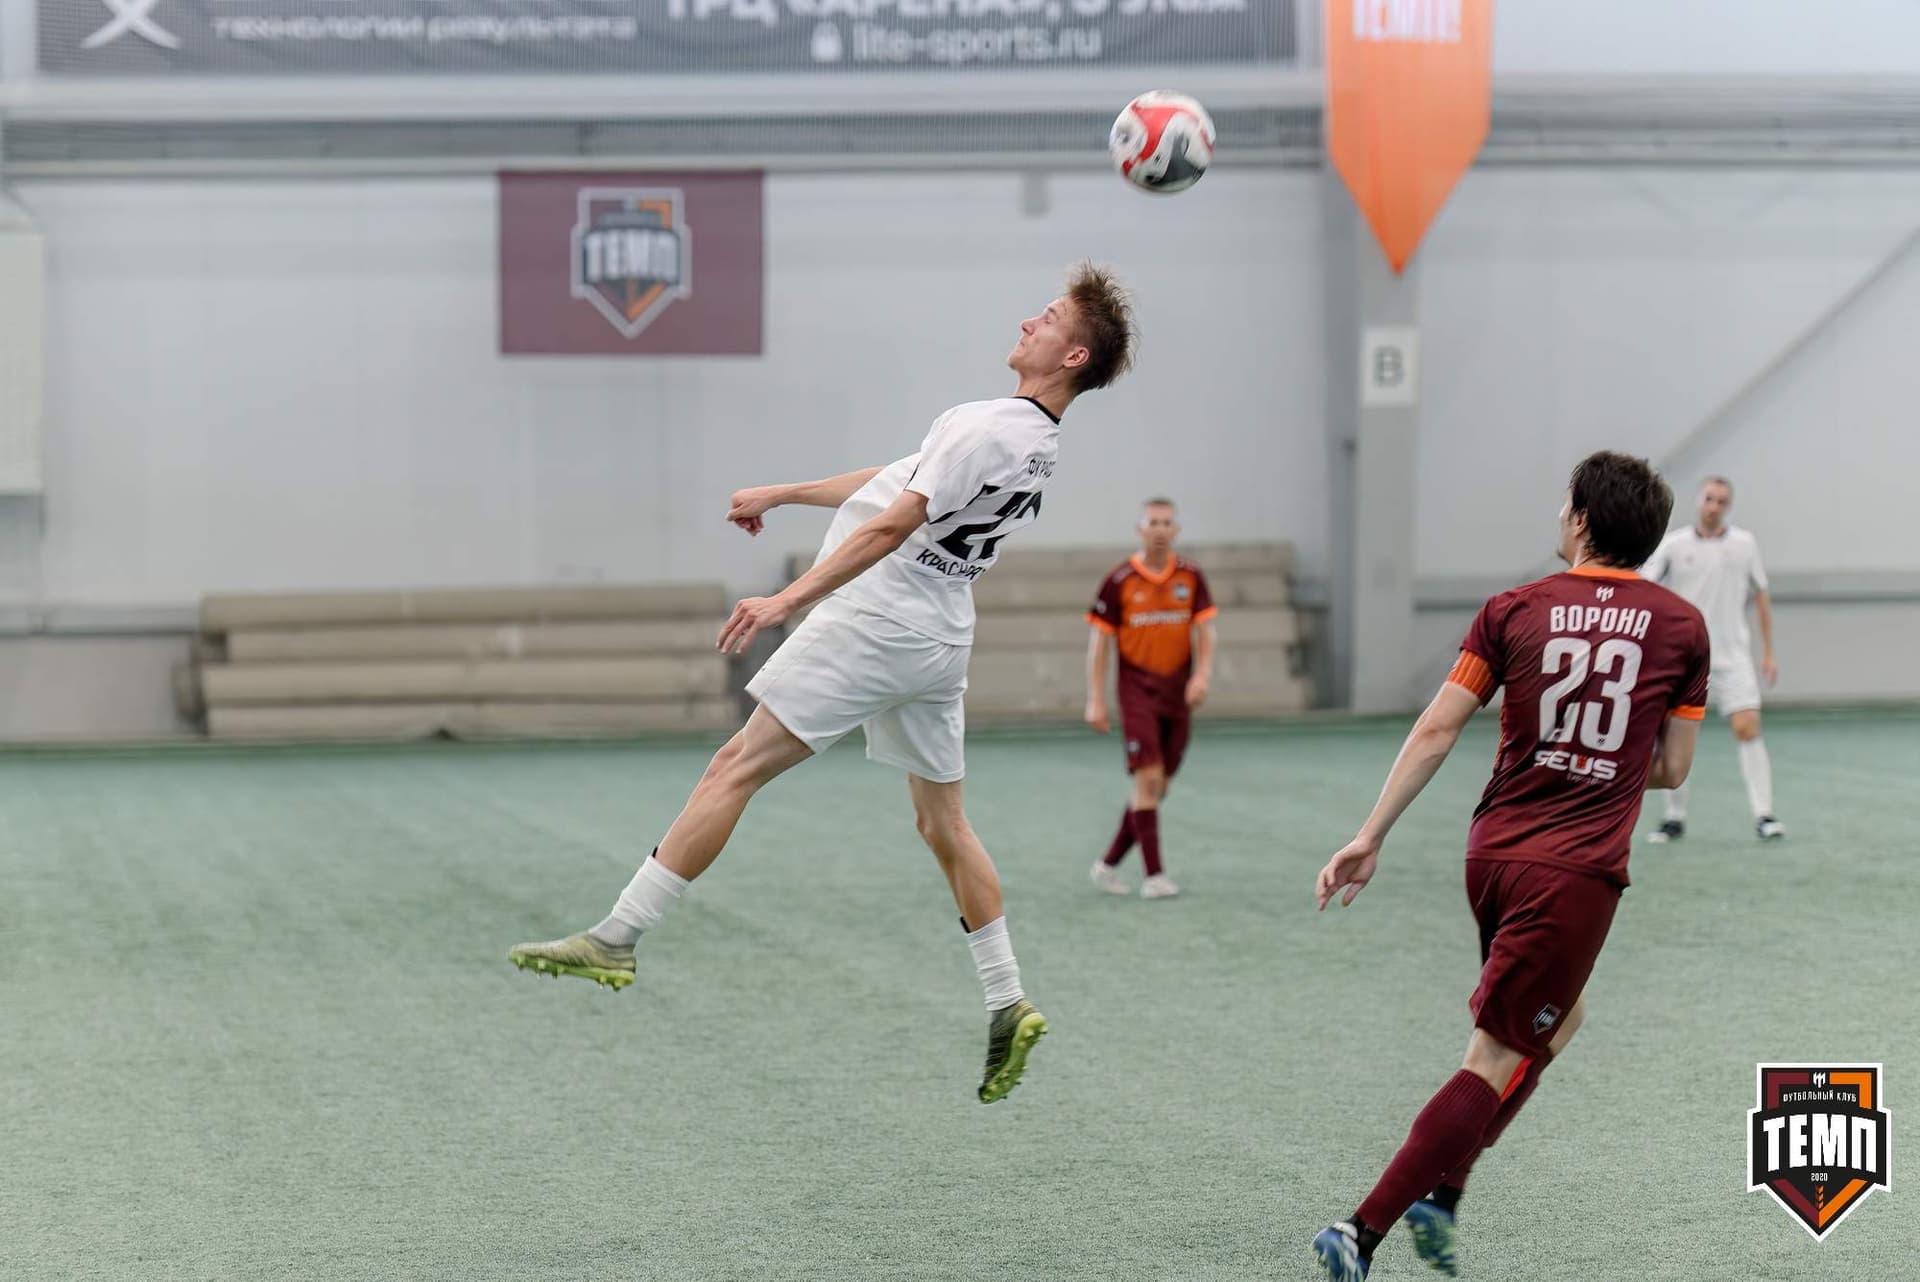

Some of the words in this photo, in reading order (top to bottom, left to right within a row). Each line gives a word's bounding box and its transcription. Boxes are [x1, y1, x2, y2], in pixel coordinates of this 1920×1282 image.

[585, 229, 677, 282] ТЕМП
[1550, 604, 1652, 640] ВОРОНА
[1539, 637, 1643, 753] 23
[1534, 750, 1618, 780] SEUS
